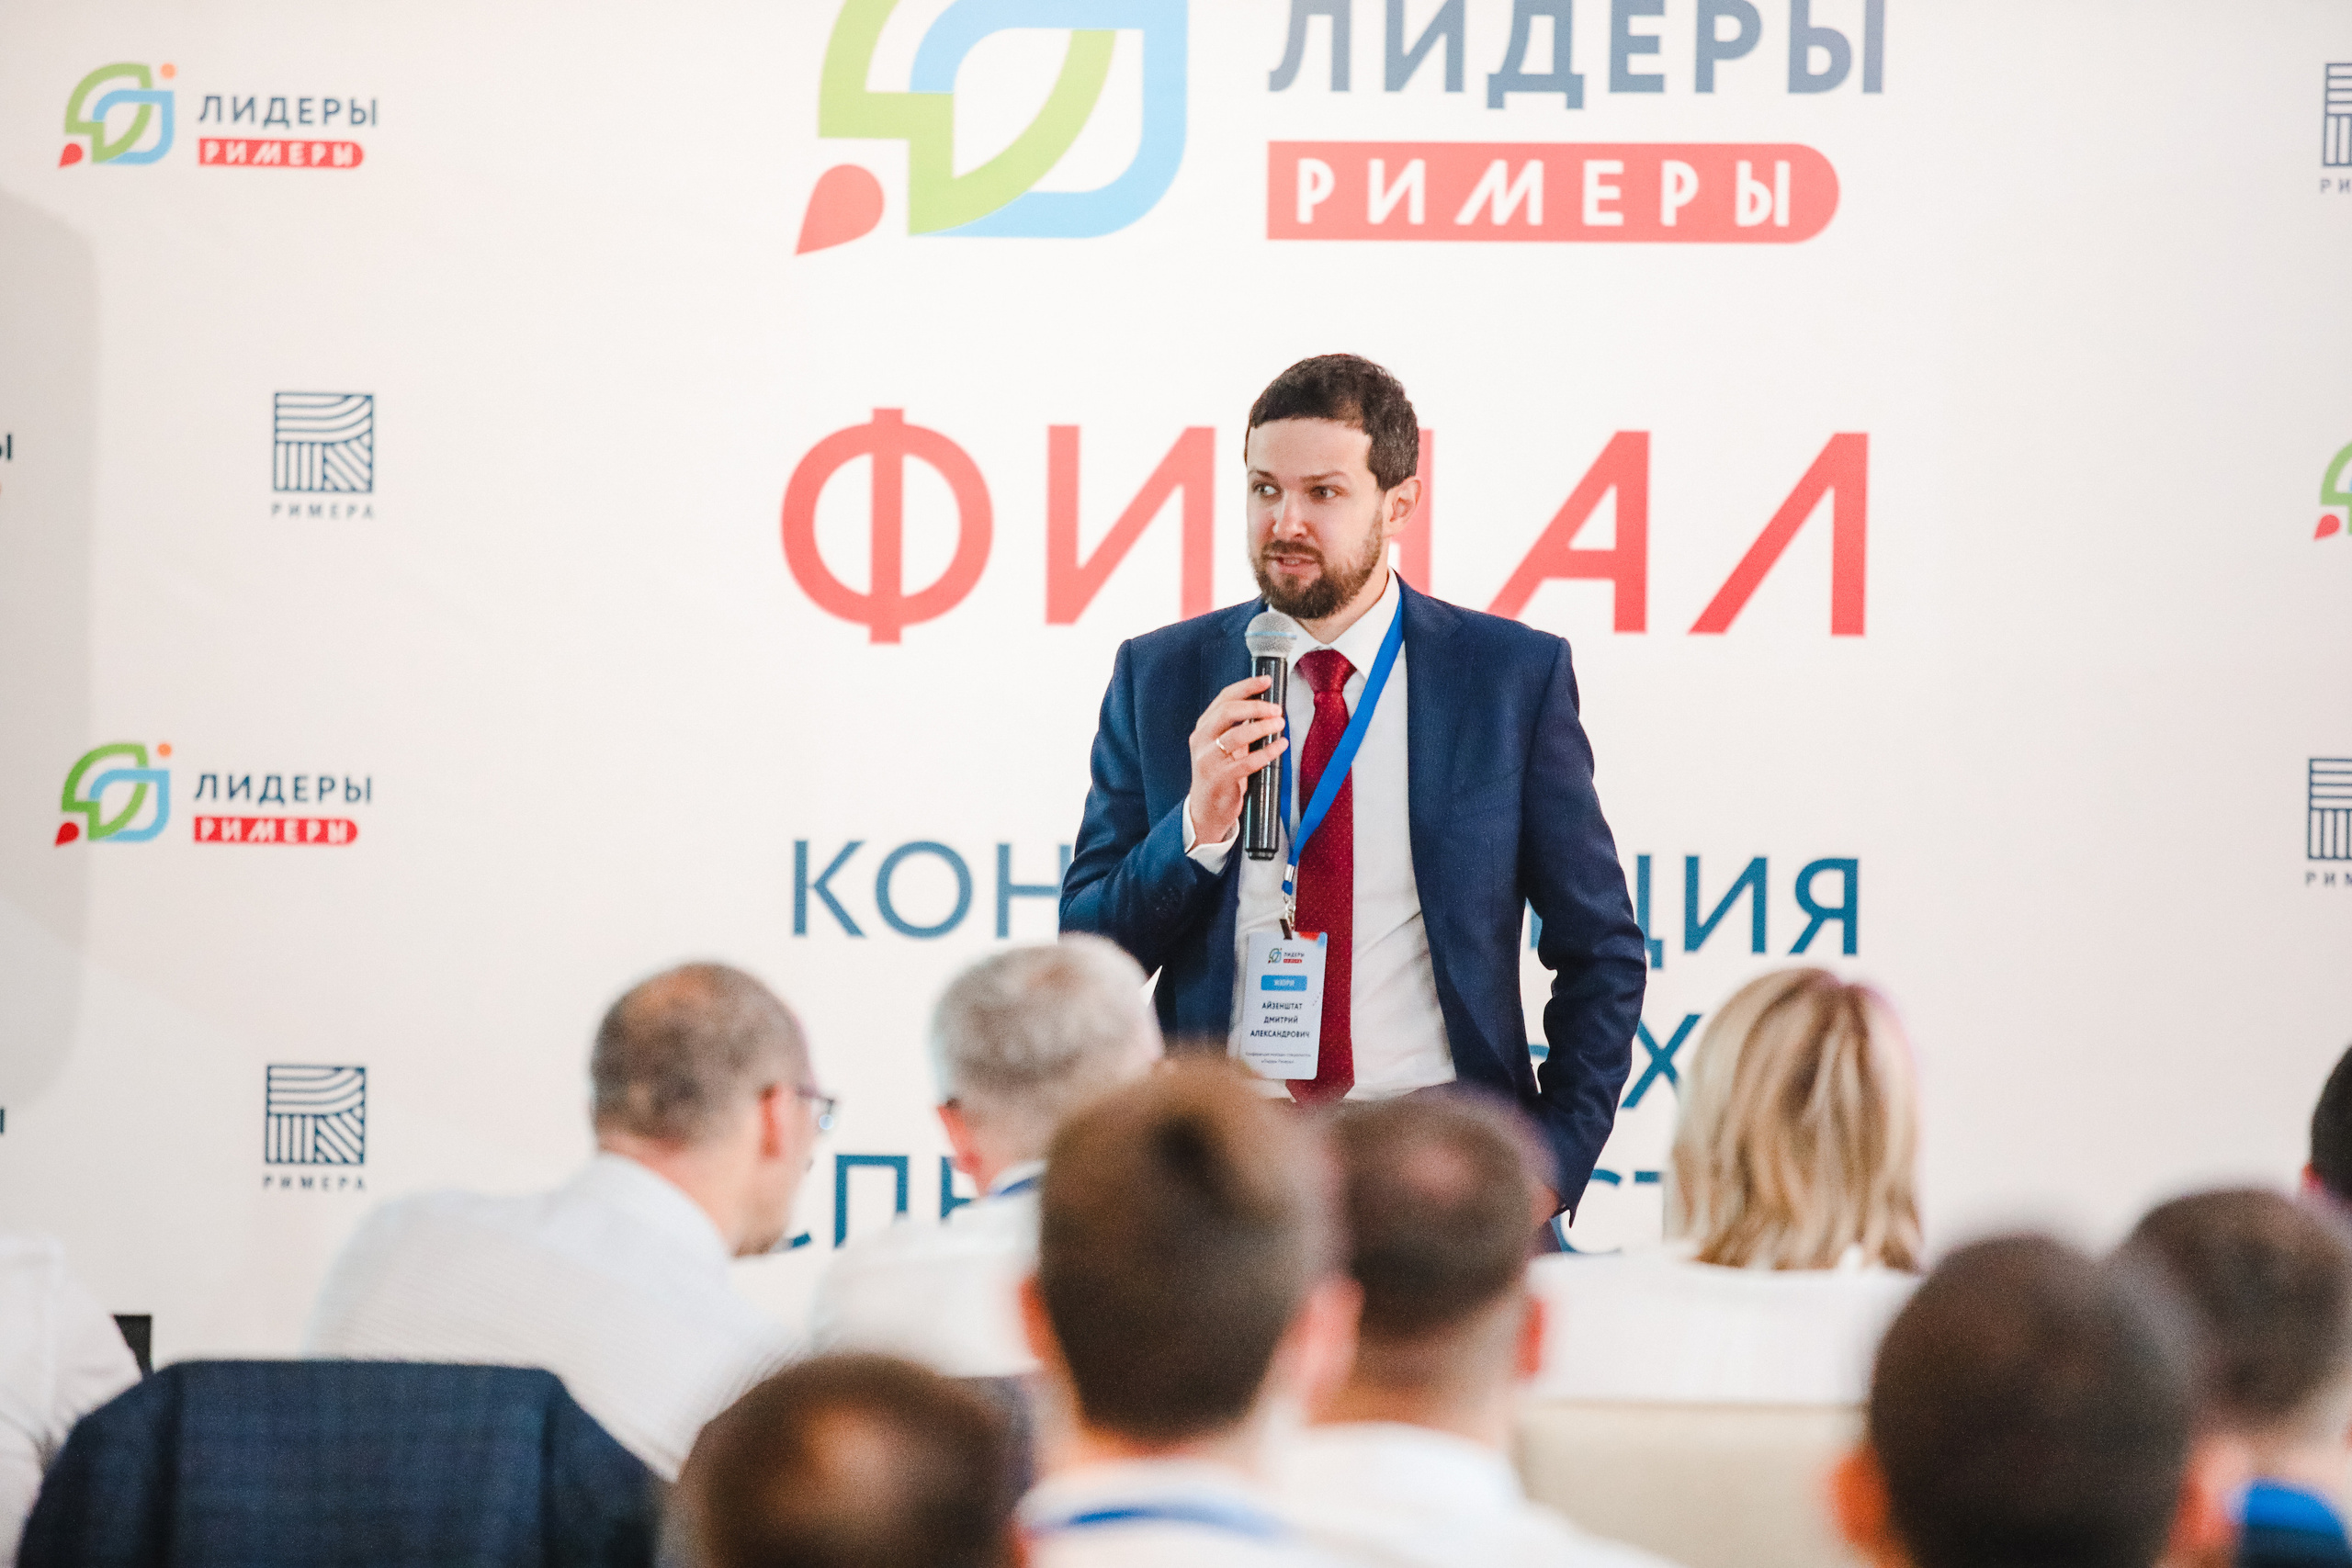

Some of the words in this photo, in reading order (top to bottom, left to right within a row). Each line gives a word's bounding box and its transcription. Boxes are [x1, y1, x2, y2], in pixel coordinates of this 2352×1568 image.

[1269, 0, 1885, 109] ЛИДЕРЫ
[199, 96, 376, 129] ЛИДЕРЫ
[204, 140, 354, 166] РИМЕРЫ
[1296, 157, 1791, 227] РИМЕРЫ
[271, 502, 373, 519] РИМЕРА
[781, 408, 1869, 645] ФИАЛ
[195, 773, 372, 806] ЛИДЕРЫ
[1261, 1000, 1303, 1010] АЙЗЕНШТАТ
[1263, 1015, 1298, 1024] ДМИТРИЙ
[1250, 1030, 1310, 1039] АЛЕКСАНДРОВИЧ
